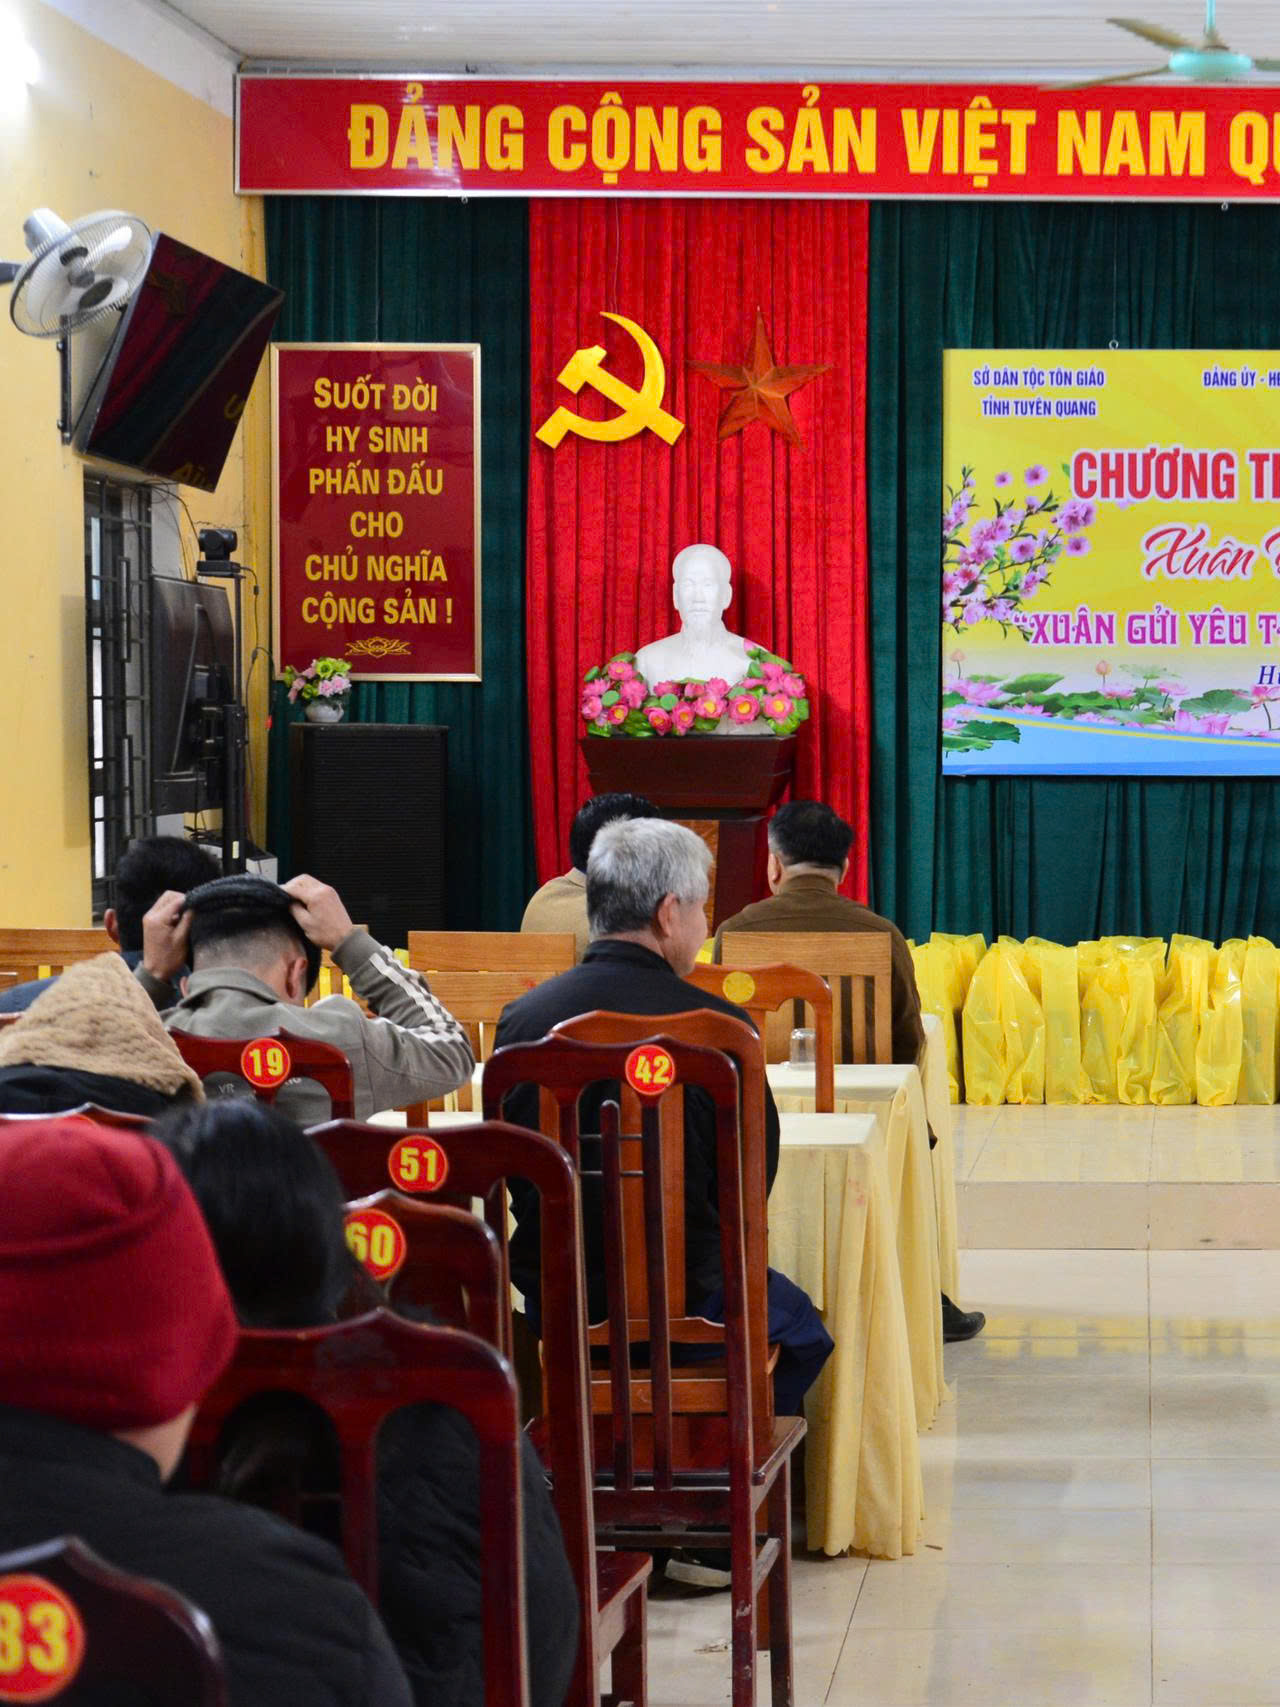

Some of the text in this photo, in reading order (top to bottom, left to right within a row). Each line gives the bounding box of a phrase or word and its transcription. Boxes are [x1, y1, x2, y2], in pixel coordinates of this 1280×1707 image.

[347, 82, 524, 170] ĐẢNG
[547, 92, 722, 184] CỘNG
[744, 85, 877, 174] SẢN
[900, 95, 1036, 188] VIỆT
[1057, 110, 1206, 176] NAM
[314, 374, 437, 412] SUỐT ĐỜI
[973, 365, 1105, 390] SỞ DÂN TỘC TÔN GIÁO
[1203, 366, 1237, 387] ĐẢNG
[1241, 366, 1256, 387] ỦY
[982, 395, 1097, 417] TỈNH TUYÊN QUANG
[326, 426, 428, 454] HY SINH
[309, 460, 443, 496] PHẤN ĐẤU
[1072, 446, 1236, 500] CHƯƠNG
[350, 511, 404, 538] CHO
[305, 545, 447, 582] CHỦ NGHĨA
[1144, 527, 1255, 577] Xuân
[302, 591, 376, 630] CỘNG
[383, 588, 436, 625] SẢN
[1127, 604, 1177, 645] GỬI
[1188, 607, 1247, 645] YÊU
[249, 1047, 284, 1077] 19
[634, 1055, 672, 1084] 42
[400, 1147, 437, 1182] 51
[345, 1222, 395, 1267] 60
